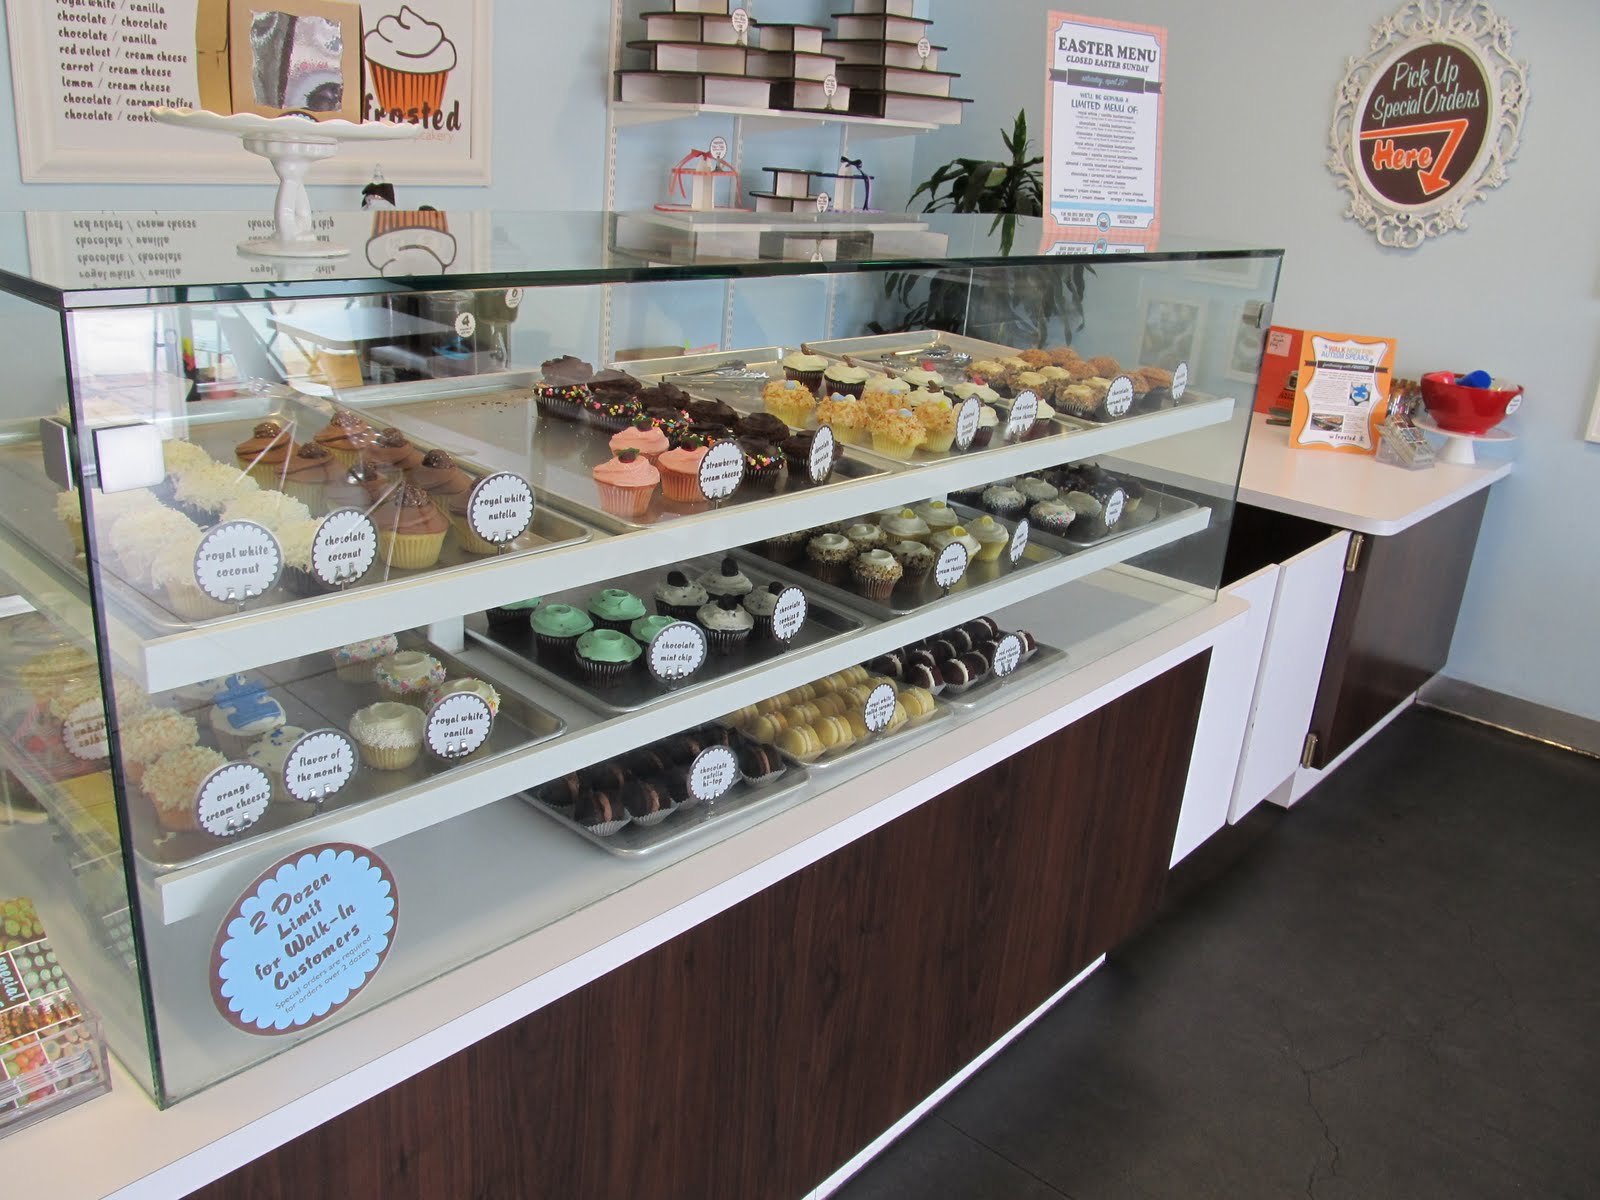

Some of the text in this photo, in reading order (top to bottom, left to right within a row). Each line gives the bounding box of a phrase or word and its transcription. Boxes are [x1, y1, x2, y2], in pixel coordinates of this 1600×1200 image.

[89, 0, 116, 9] white
[130, 4, 165, 14] vanilla
[58, 10, 107, 25] chocolate
[122, 17, 167, 30] chocolate
[59, 27, 107, 41] chocolate
[122, 34, 157, 45] vanilla
[60, 44, 76, 55] red
[80, 46, 110, 57] velvet
[125, 51, 153, 60] cream
[157, 52, 187, 63] cheese
[1059, 37, 1156, 63] EASTER MENU
[61, 62, 94, 72] carrot
[109, 66, 138, 75] cream
[141, 66, 171, 77] cheese
[1067, 55, 1149, 73] CLOSED EASTER SUNDAY
[1393, 56, 1459, 92] Pick Up
[62, 77, 93, 88] lemon
[108, 81, 137, 91] cream
[140, 81, 170, 93] cheese
[64, 93, 112, 105] chocolate
[126, 98, 163, 107] caramel
[167, 98, 193, 108] toffee
[1072, 100, 1100, 110] LIMITED
[1104, 103, 1124, 113] MENU
[1372, 83, 1480, 127] Special Orders
[65, 109, 112, 121] chocolate
[1372, 139, 1433, 170] Here
[462, 315, 470, 327] 4
[1321, 351, 1344, 359] AUTISM
[707, 459, 739, 470] strawberry
[703, 471, 739, 483] cream cheese
[480, 494, 526, 508] royal white
[488, 510, 517, 522] nutella
[325, 532, 365, 546] chocolate
[205, 546, 269, 562] royal white
[328, 548, 362, 562] coconut
[217, 563, 260, 578] coconut
[779, 601, 801, 614] chocolate
[779, 614, 795, 625] cookies
[783, 620, 796, 629] cream
[662, 641, 695, 649] chocolate
[678, 653, 693, 663] chip
[436, 712, 484, 726] royal white
[444, 728, 474, 738] vanilla
[299, 749, 341, 768] flavor of
[297, 765, 343, 783] the month
[700, 762, 727, 774] chocolate
[703, 772, 723, 780] nutella
[703, 778, 722, 787] hi-top
[216, 782, 251, 803] orange
[206, 791, 267, 823] cream cheese
[250, 872, 332, 935] 2 Dozen
[277, 899, 323, 940] Limit
[255, 904, 356, 981] for Walk-In
[274, 923, 360, 991] Customers
[275, 936, 372, 1009] Special orders are required
[285, 948, 371, 1014] for orders over 2 dozen
